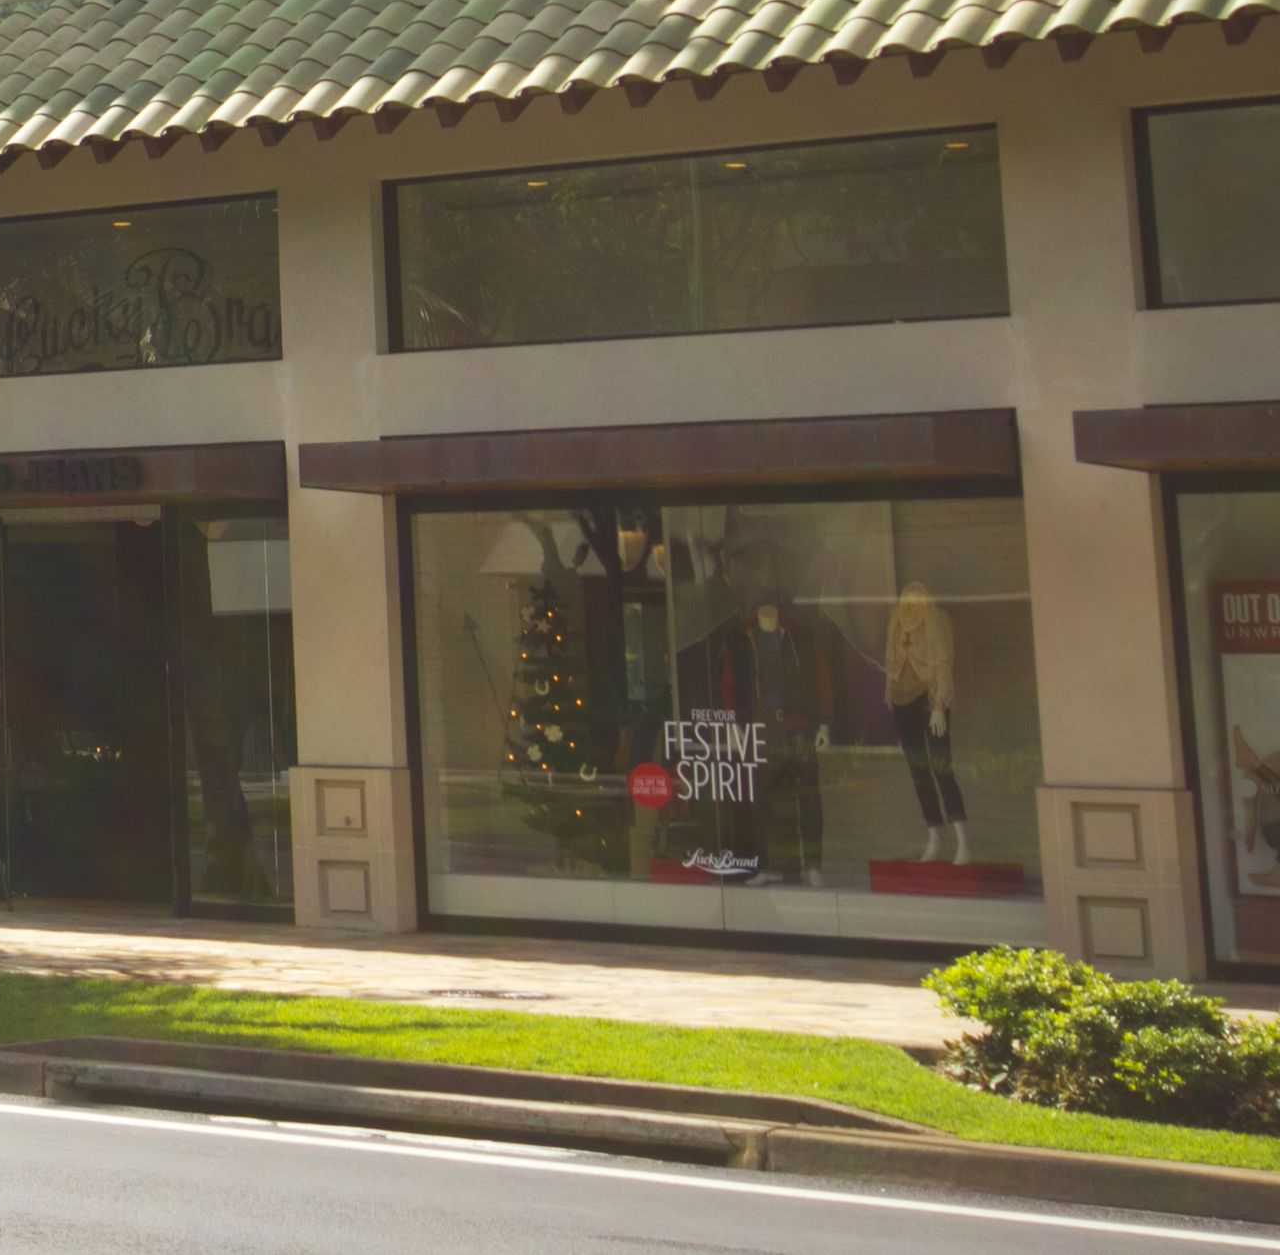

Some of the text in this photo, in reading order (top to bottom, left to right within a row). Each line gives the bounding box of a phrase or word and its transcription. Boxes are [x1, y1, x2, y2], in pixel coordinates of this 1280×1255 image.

[19, 456, 141, 494] JEANS
[1223, 593, 1261, 623] OUT
[691, 709, 736, 722] FREE YOUR
[664, 721, 768, 763] FESTIVE
[677, 760, 758, 803] SPIRIT
